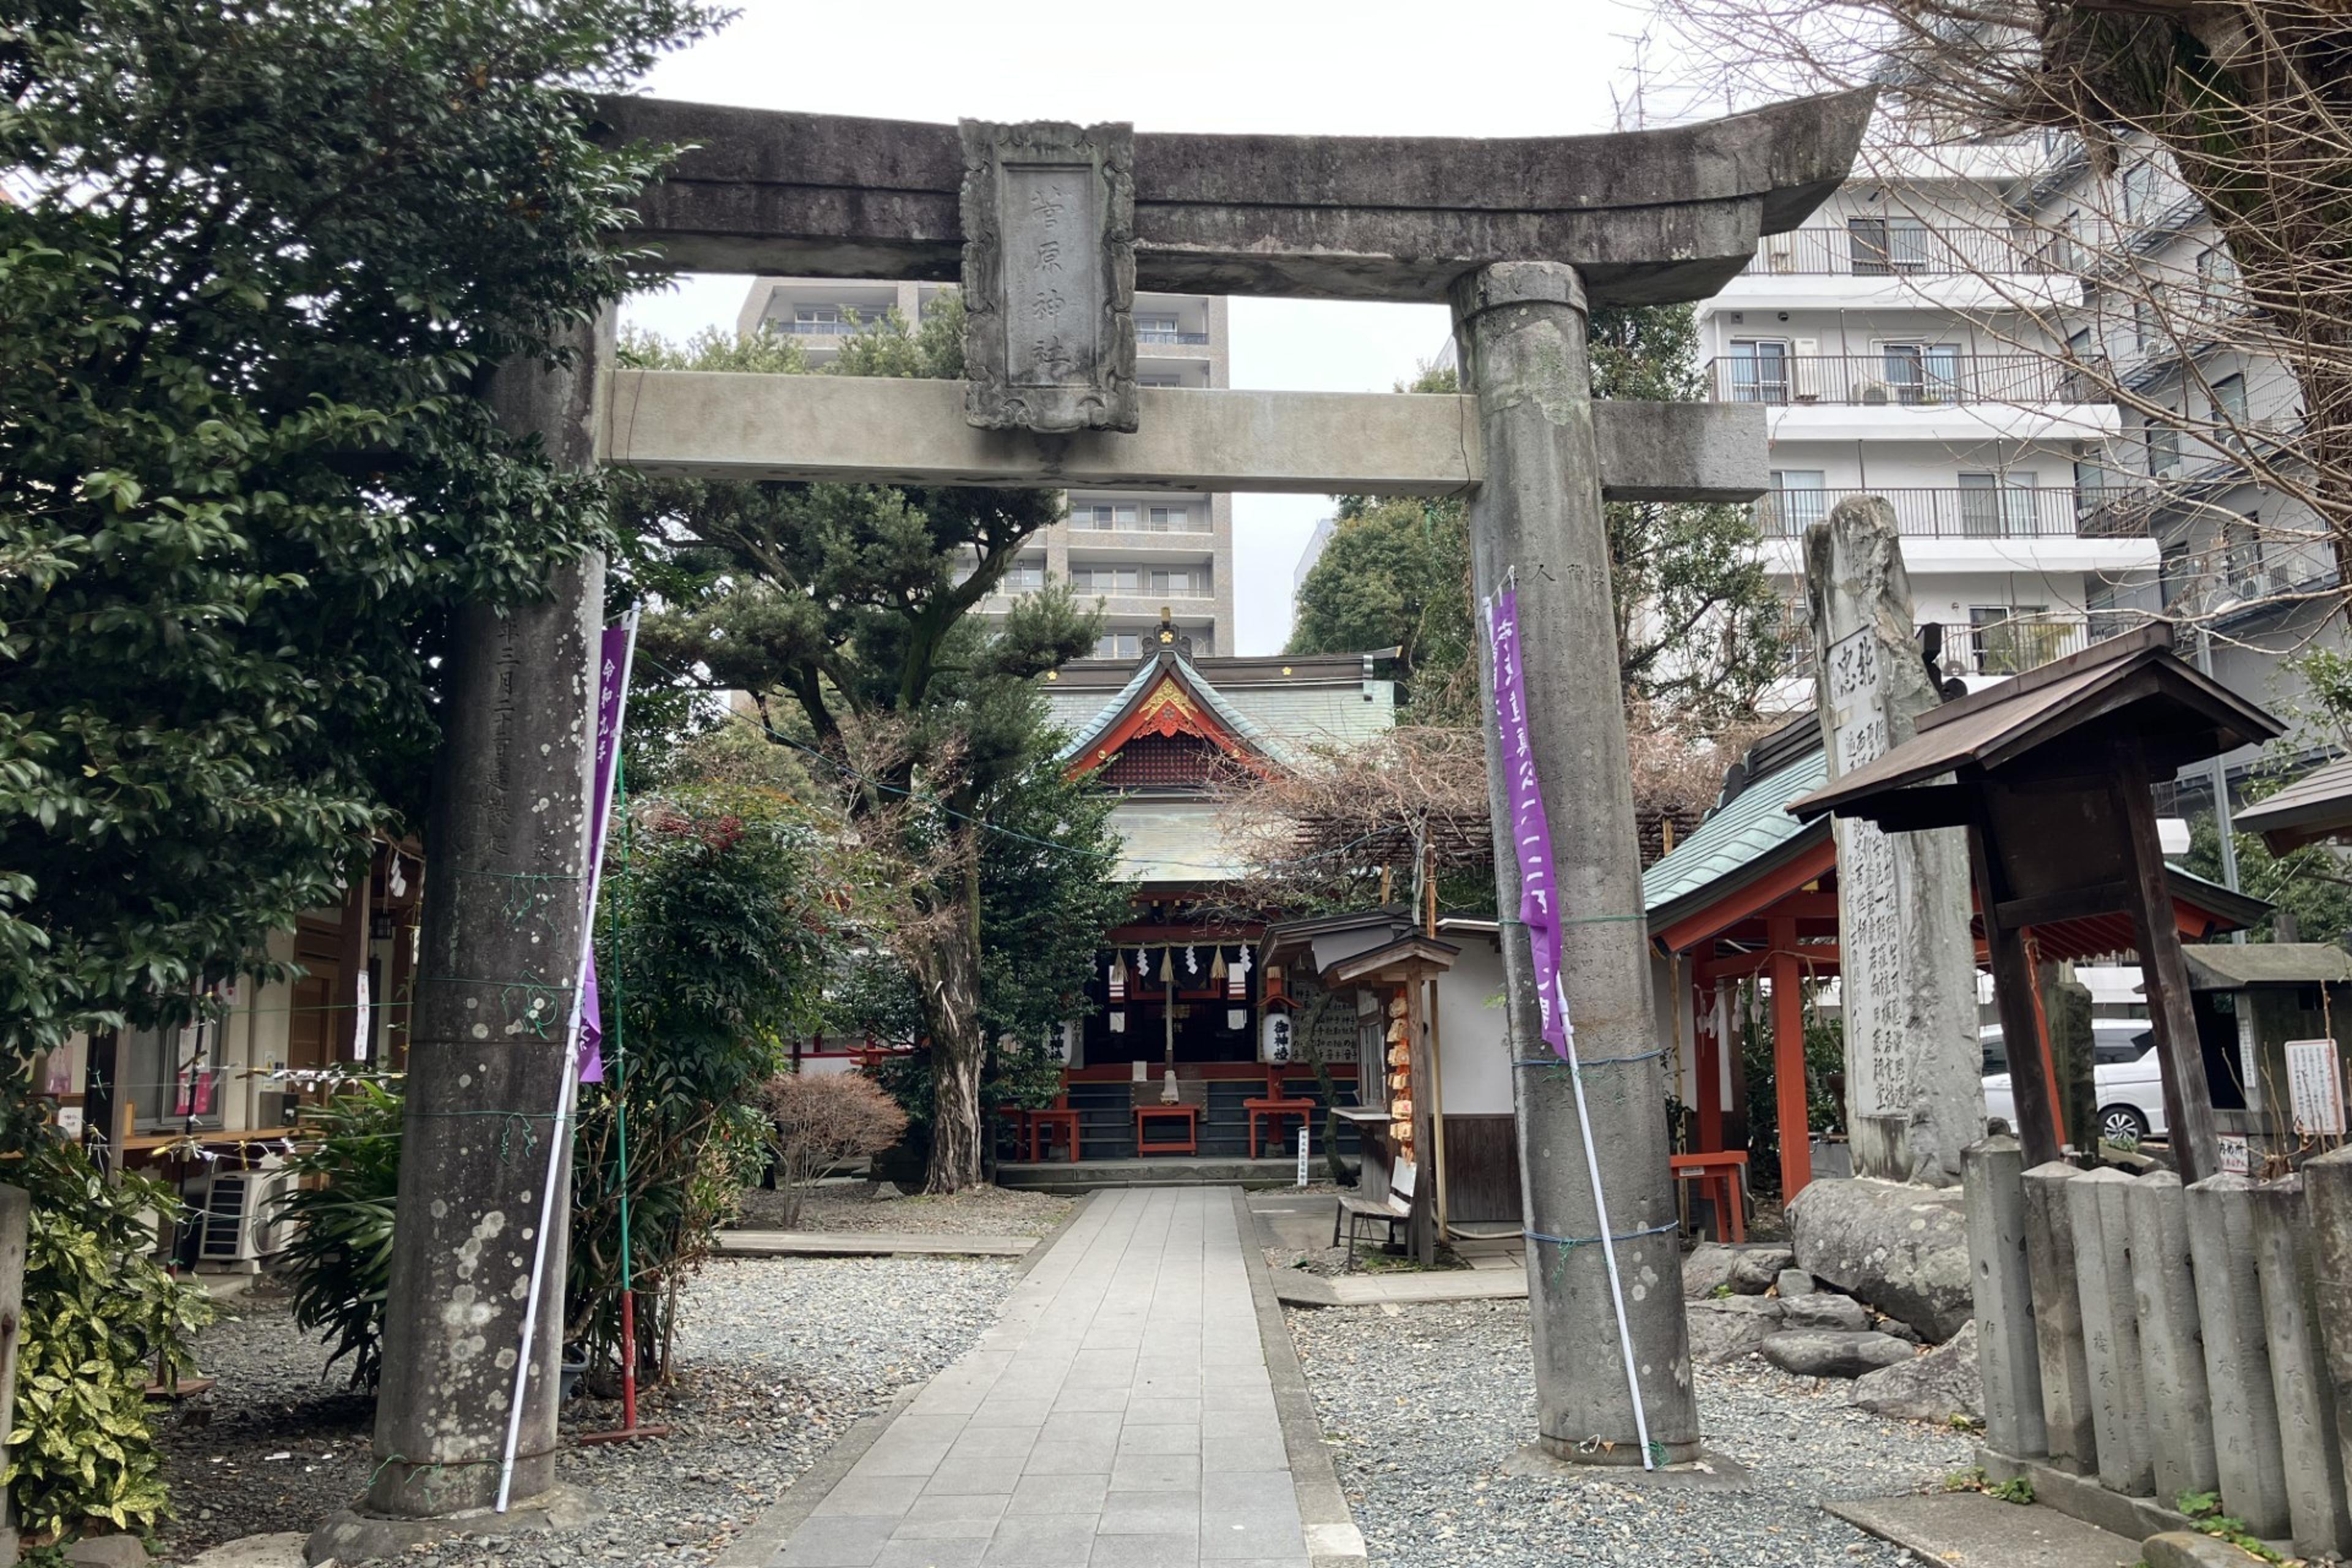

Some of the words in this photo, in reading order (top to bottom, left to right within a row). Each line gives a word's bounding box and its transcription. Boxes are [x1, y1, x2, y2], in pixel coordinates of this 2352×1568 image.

[1030, 184, 1071, 366] 菅原神社
[1274, 1019, 1289, 1060] 御神燈
